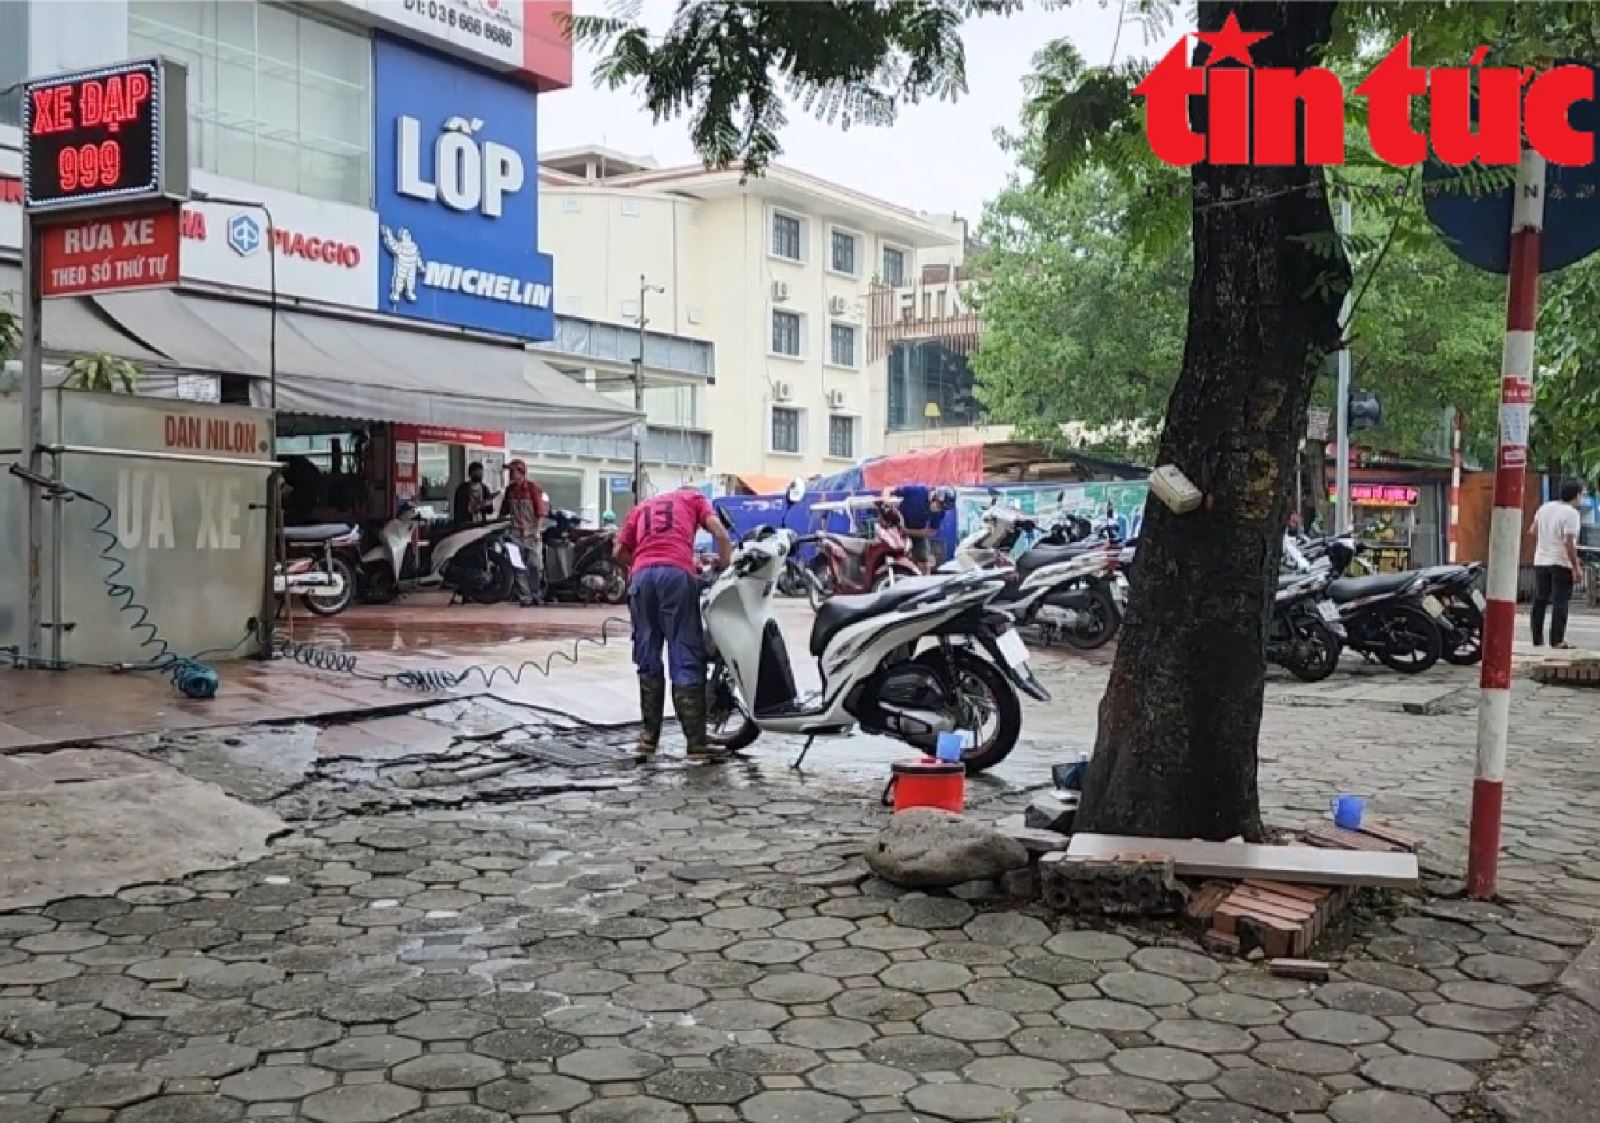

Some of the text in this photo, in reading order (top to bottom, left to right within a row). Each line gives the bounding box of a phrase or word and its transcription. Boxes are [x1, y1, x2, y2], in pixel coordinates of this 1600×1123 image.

[32, 73, 149, 135] XE ĐẠP
[59, 140, 121, 191] 999
[396, 115, 525, 219] LỐP
[121, 218, 155, 247] XE
[266, 227, 361, 269] PIAGGIO
[51, 252, 170, 288] THEO SỐ THỨ TỰ
[423, 260, 551, 309] MICHELIN
[164, 414, 256, 454] DAN NILON
[195, 475, 241, 551] XE
[643, 500, 673, 534] 13
